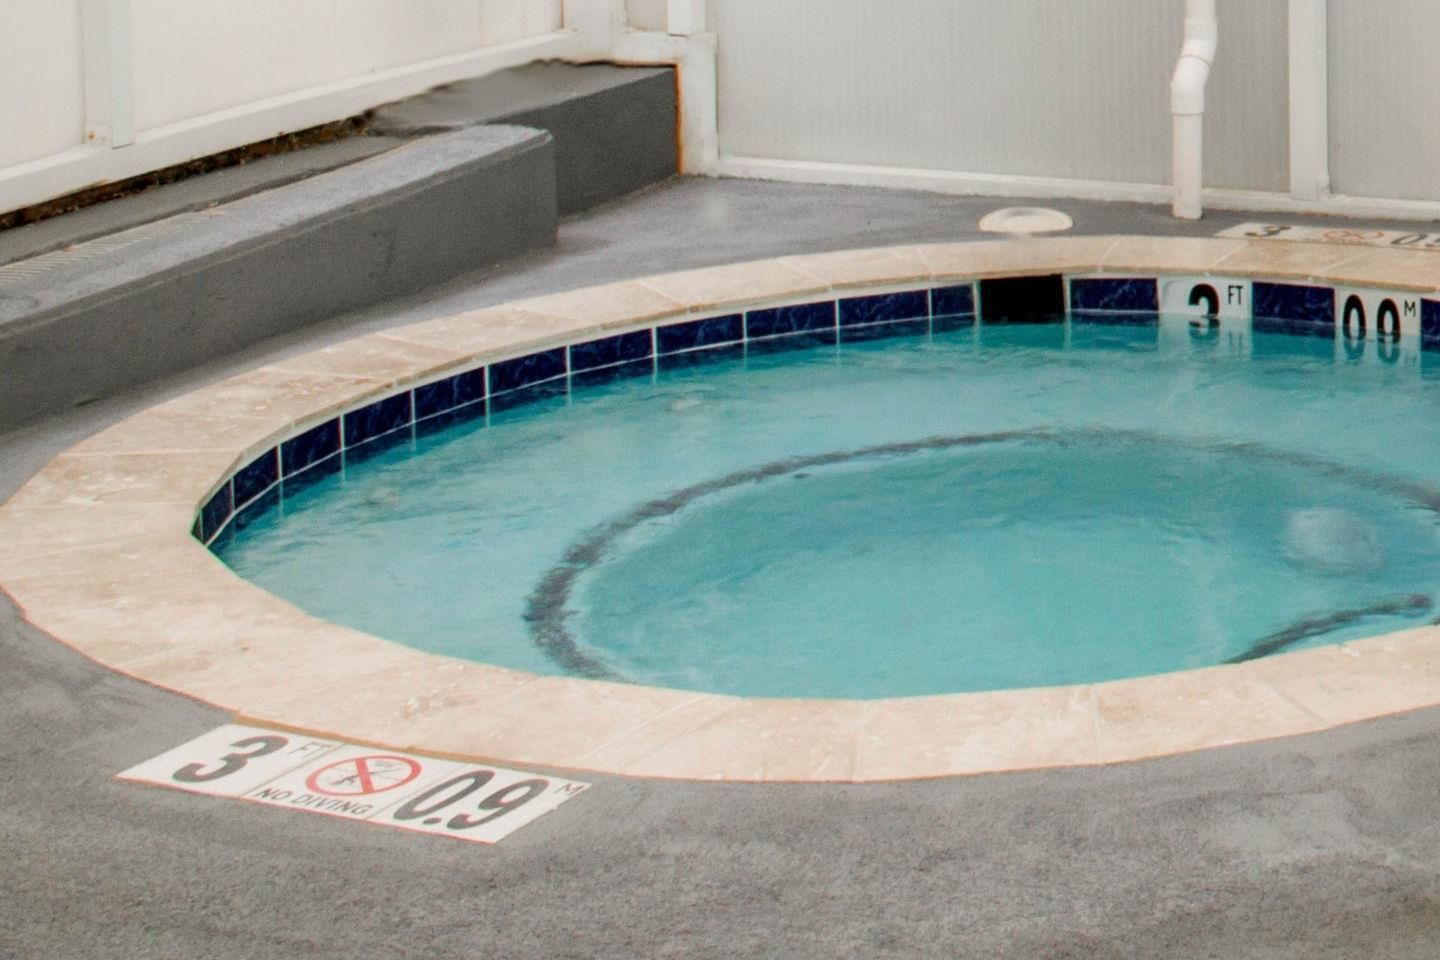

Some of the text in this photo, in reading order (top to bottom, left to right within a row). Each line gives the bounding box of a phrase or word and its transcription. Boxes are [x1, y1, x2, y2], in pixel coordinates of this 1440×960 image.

[1227, 285, 1243, 306] FT
[1404, 301, 1416, 317] M
[172, 735, 332, 783] 3 FT
[256, 787, 371, 815] NO DIVING
[392, 769, 583, 830] 0.9 M
